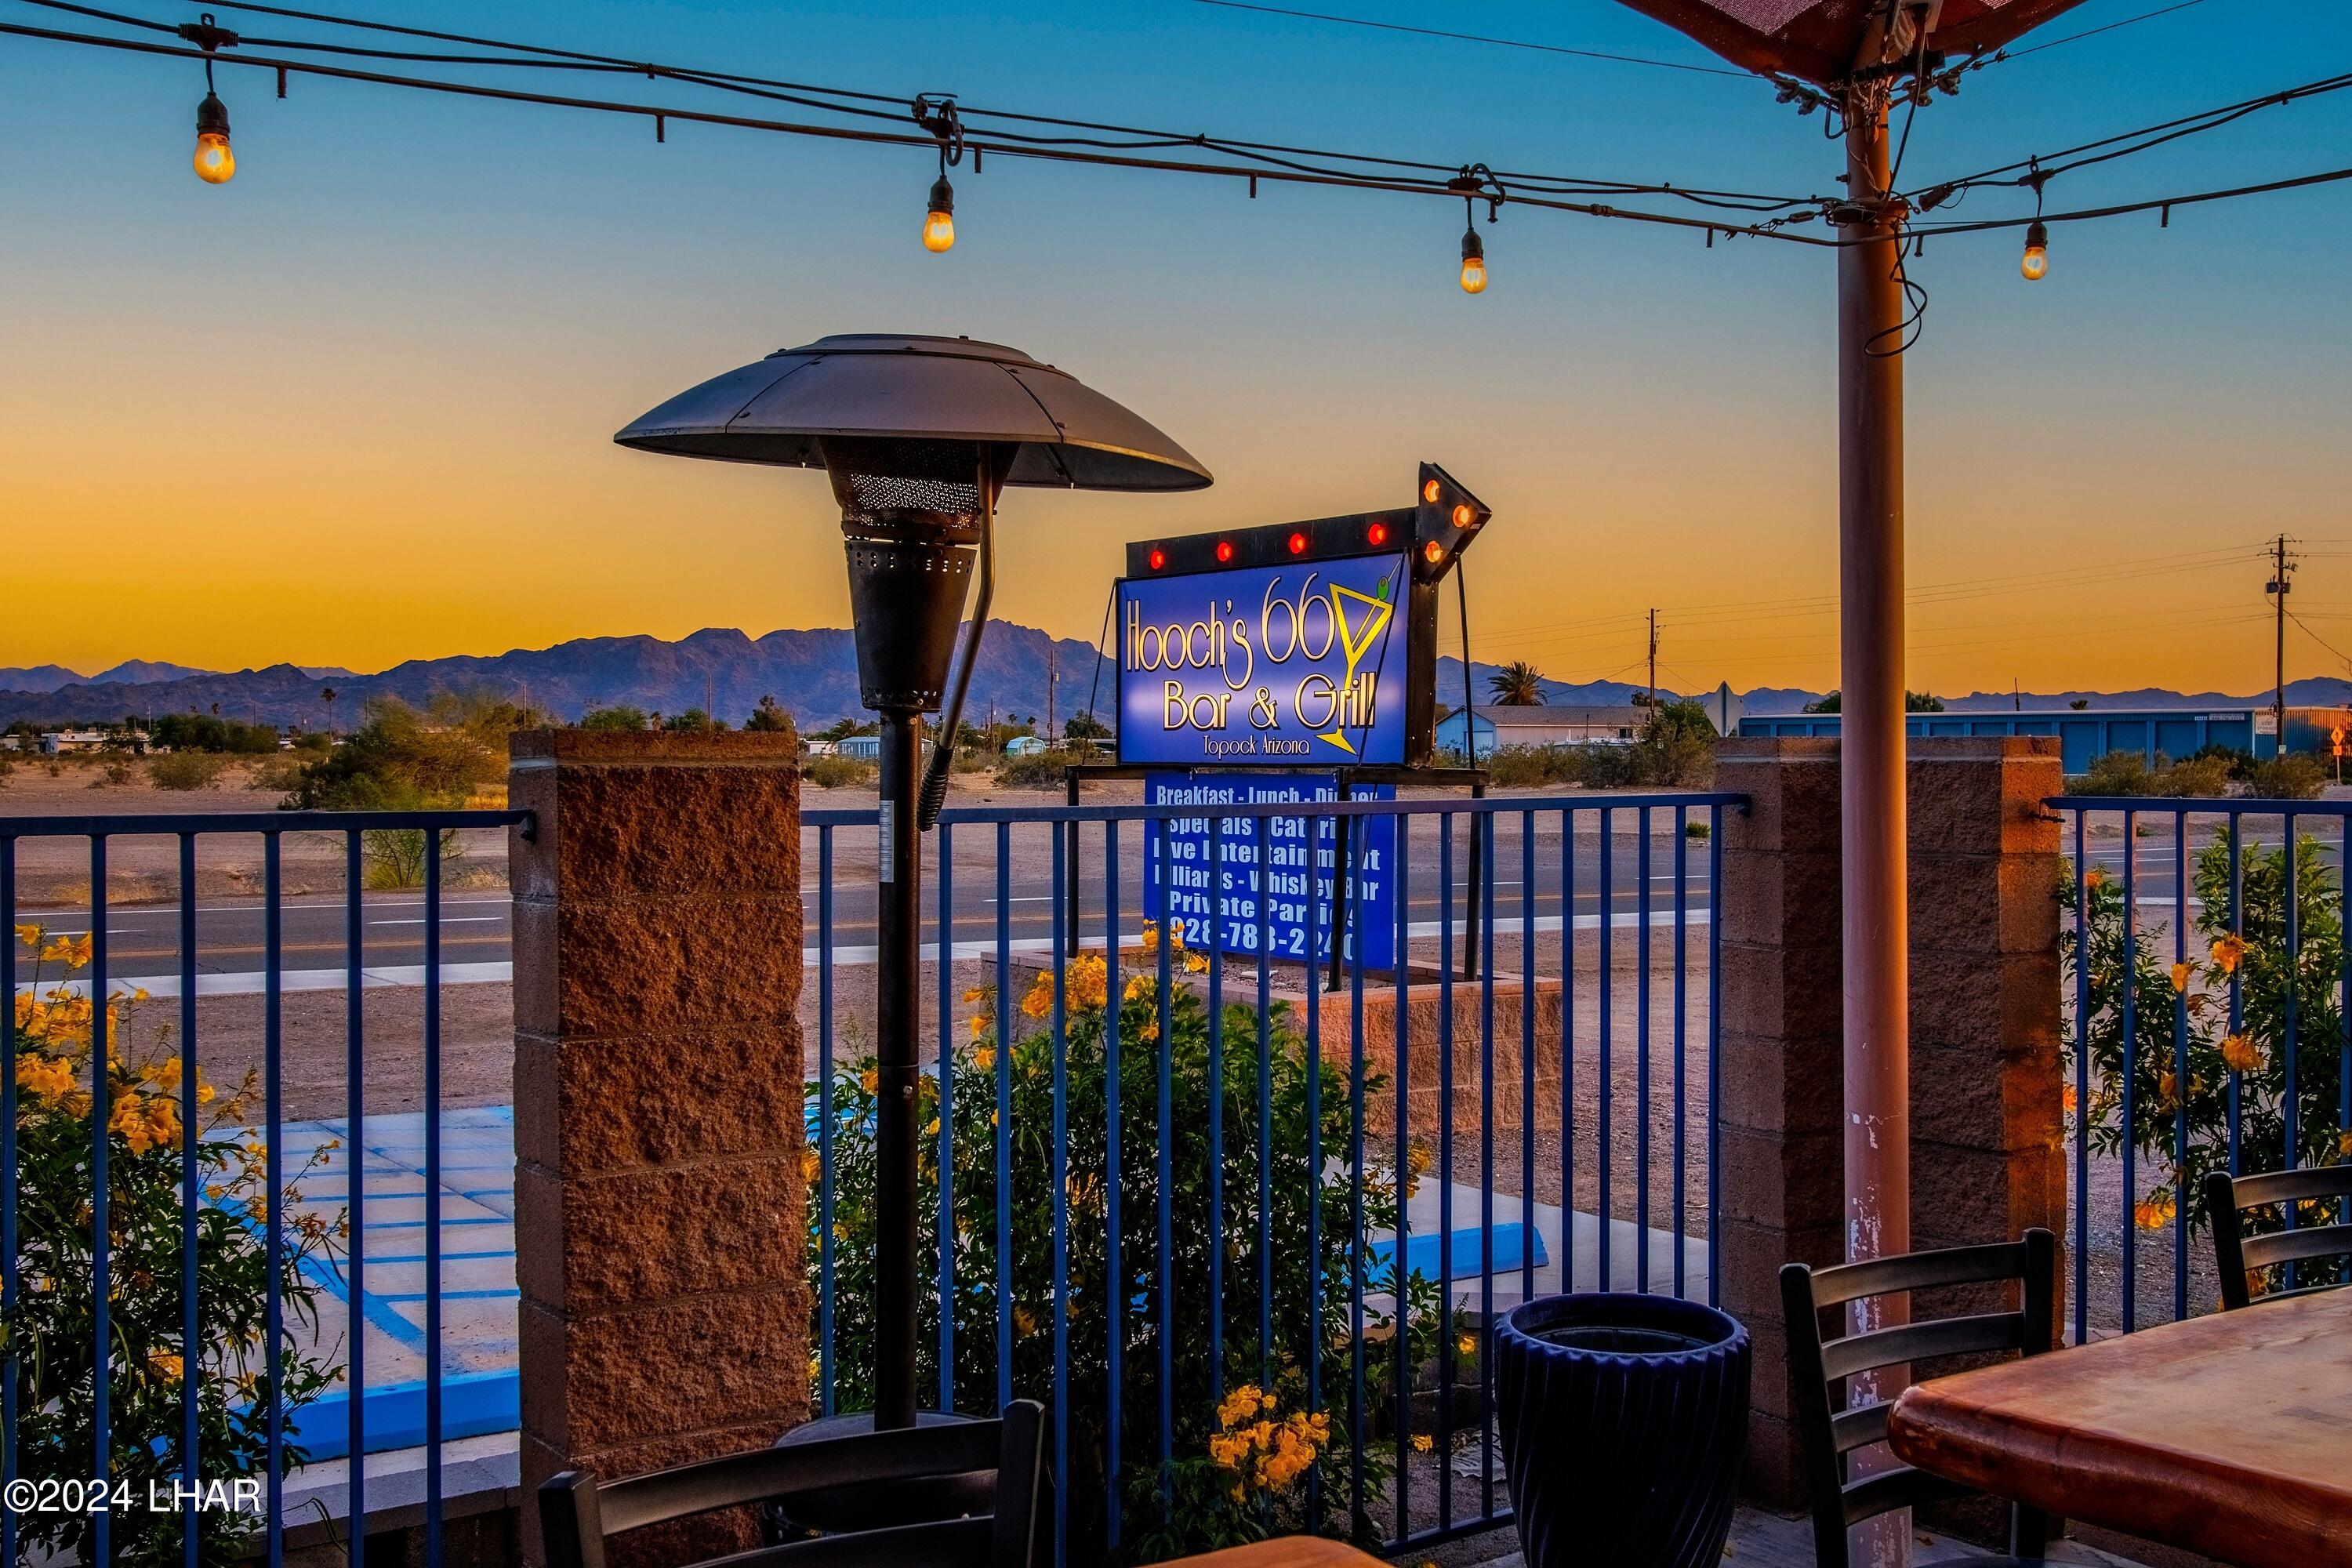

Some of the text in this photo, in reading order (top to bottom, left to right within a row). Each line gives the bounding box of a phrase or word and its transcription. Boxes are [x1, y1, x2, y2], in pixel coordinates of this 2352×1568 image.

[1126, 572, 1335, 690] Hooch's 66
[1163, 672, 1376, 730] Bar & Grill
[1203, 733, 1310, 760] Topock Arizona
[1156, 786, 1234, 805] Breakfast
